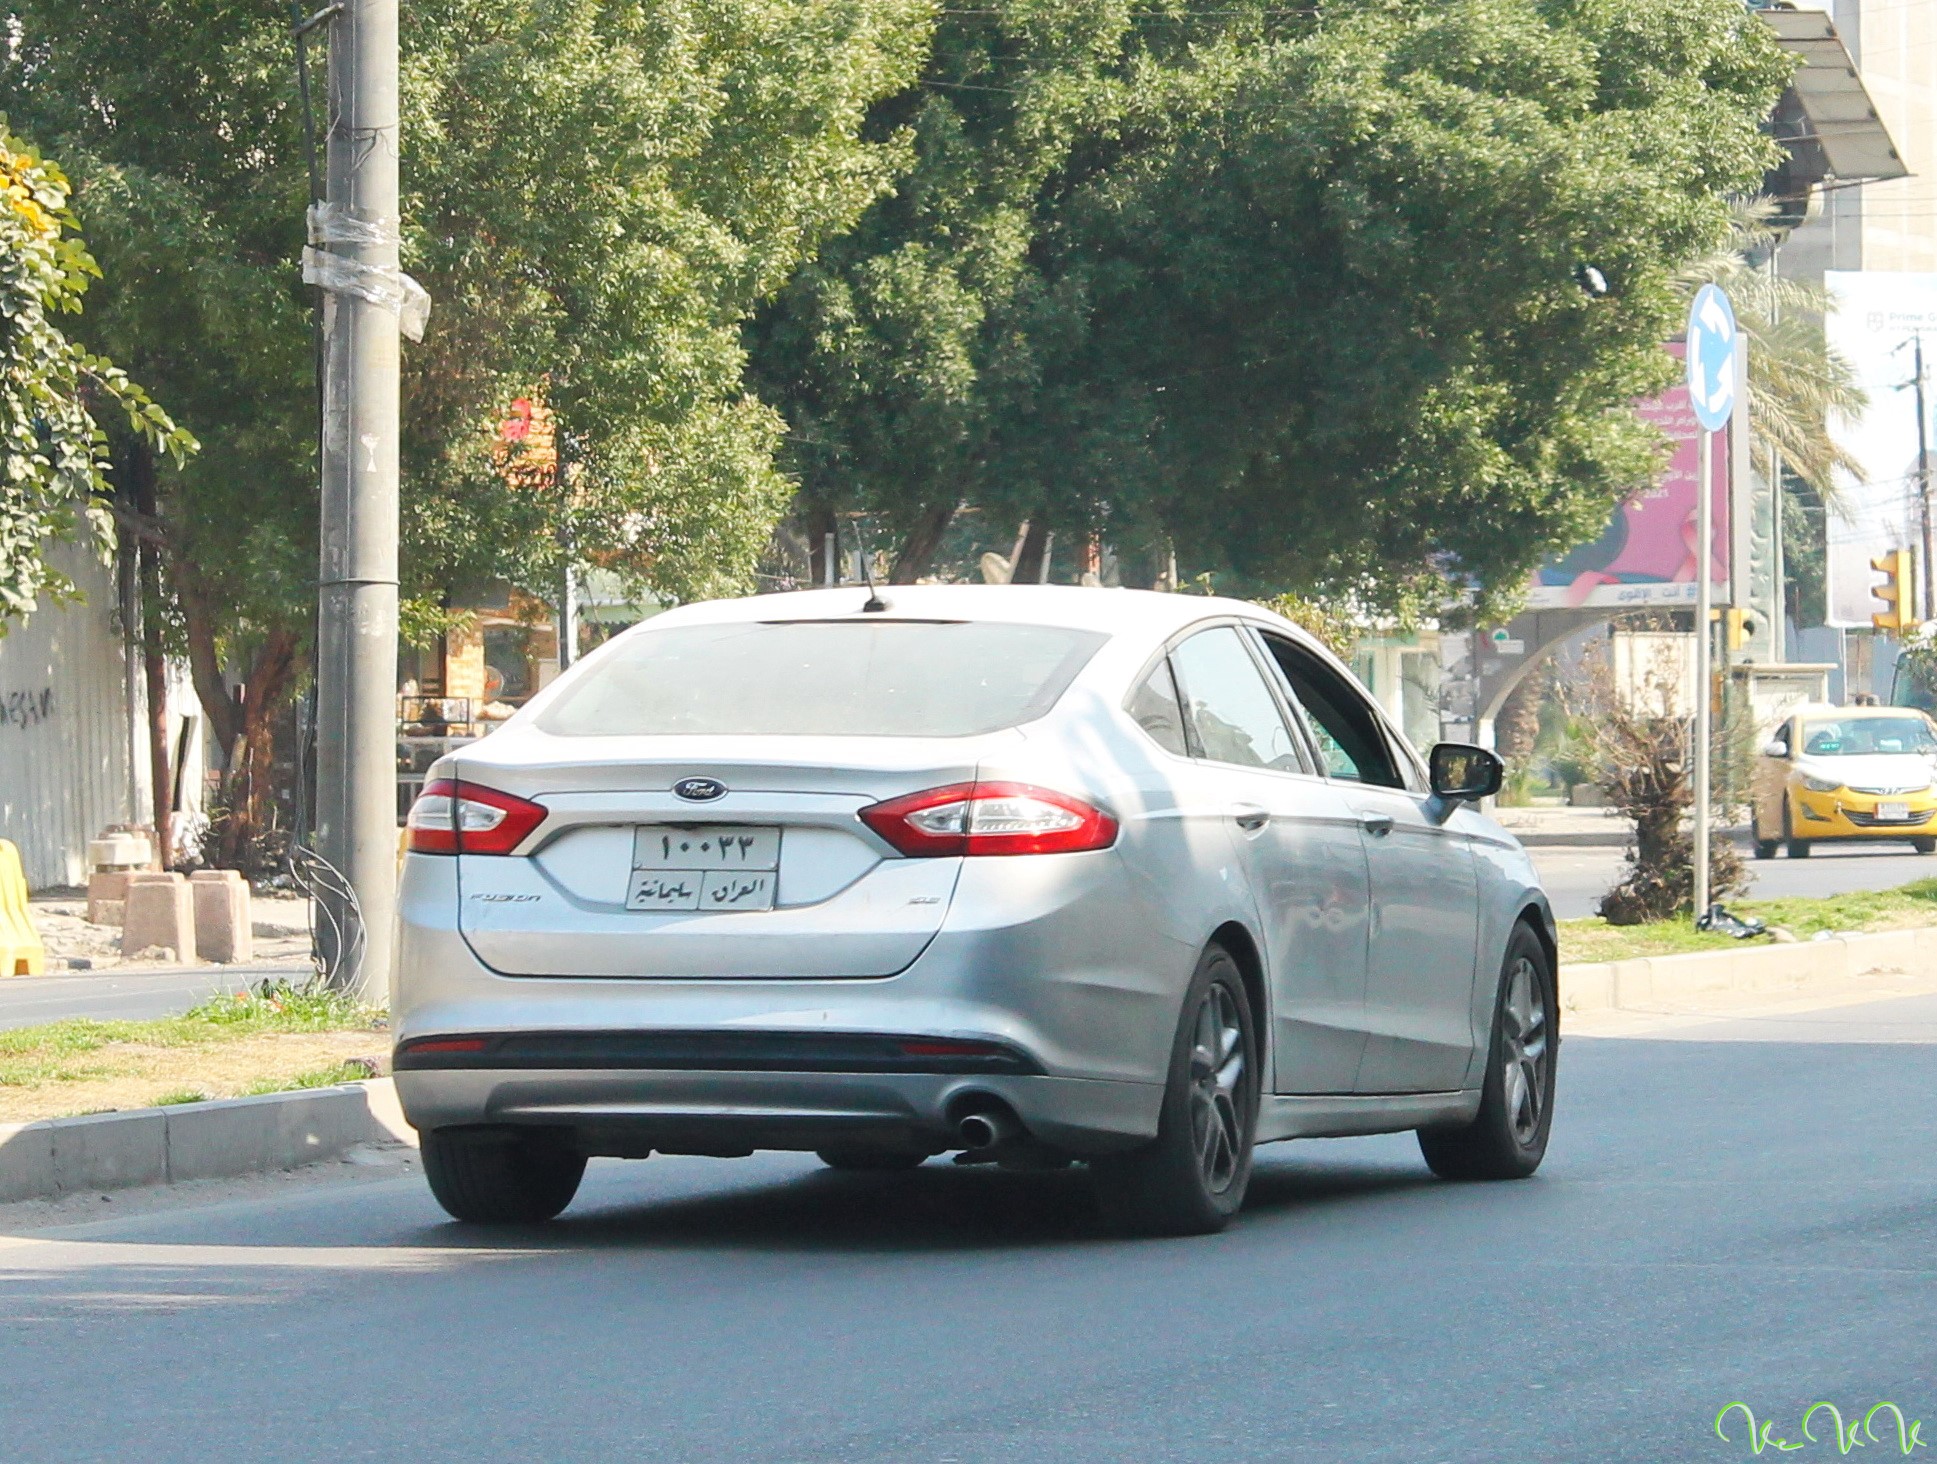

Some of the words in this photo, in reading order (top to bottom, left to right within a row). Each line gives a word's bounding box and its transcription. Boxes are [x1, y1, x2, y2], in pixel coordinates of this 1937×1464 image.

[1889, 311, 1924, 321] Prime
[1927, 311, 1937, 322] G
[683, 781, 716, 797] Ford
[661, 834, 755, 861] ١٠٠٣٣
[635, 878, 693, 904] سليمانية
[711, 878, 765, 903] العراق
